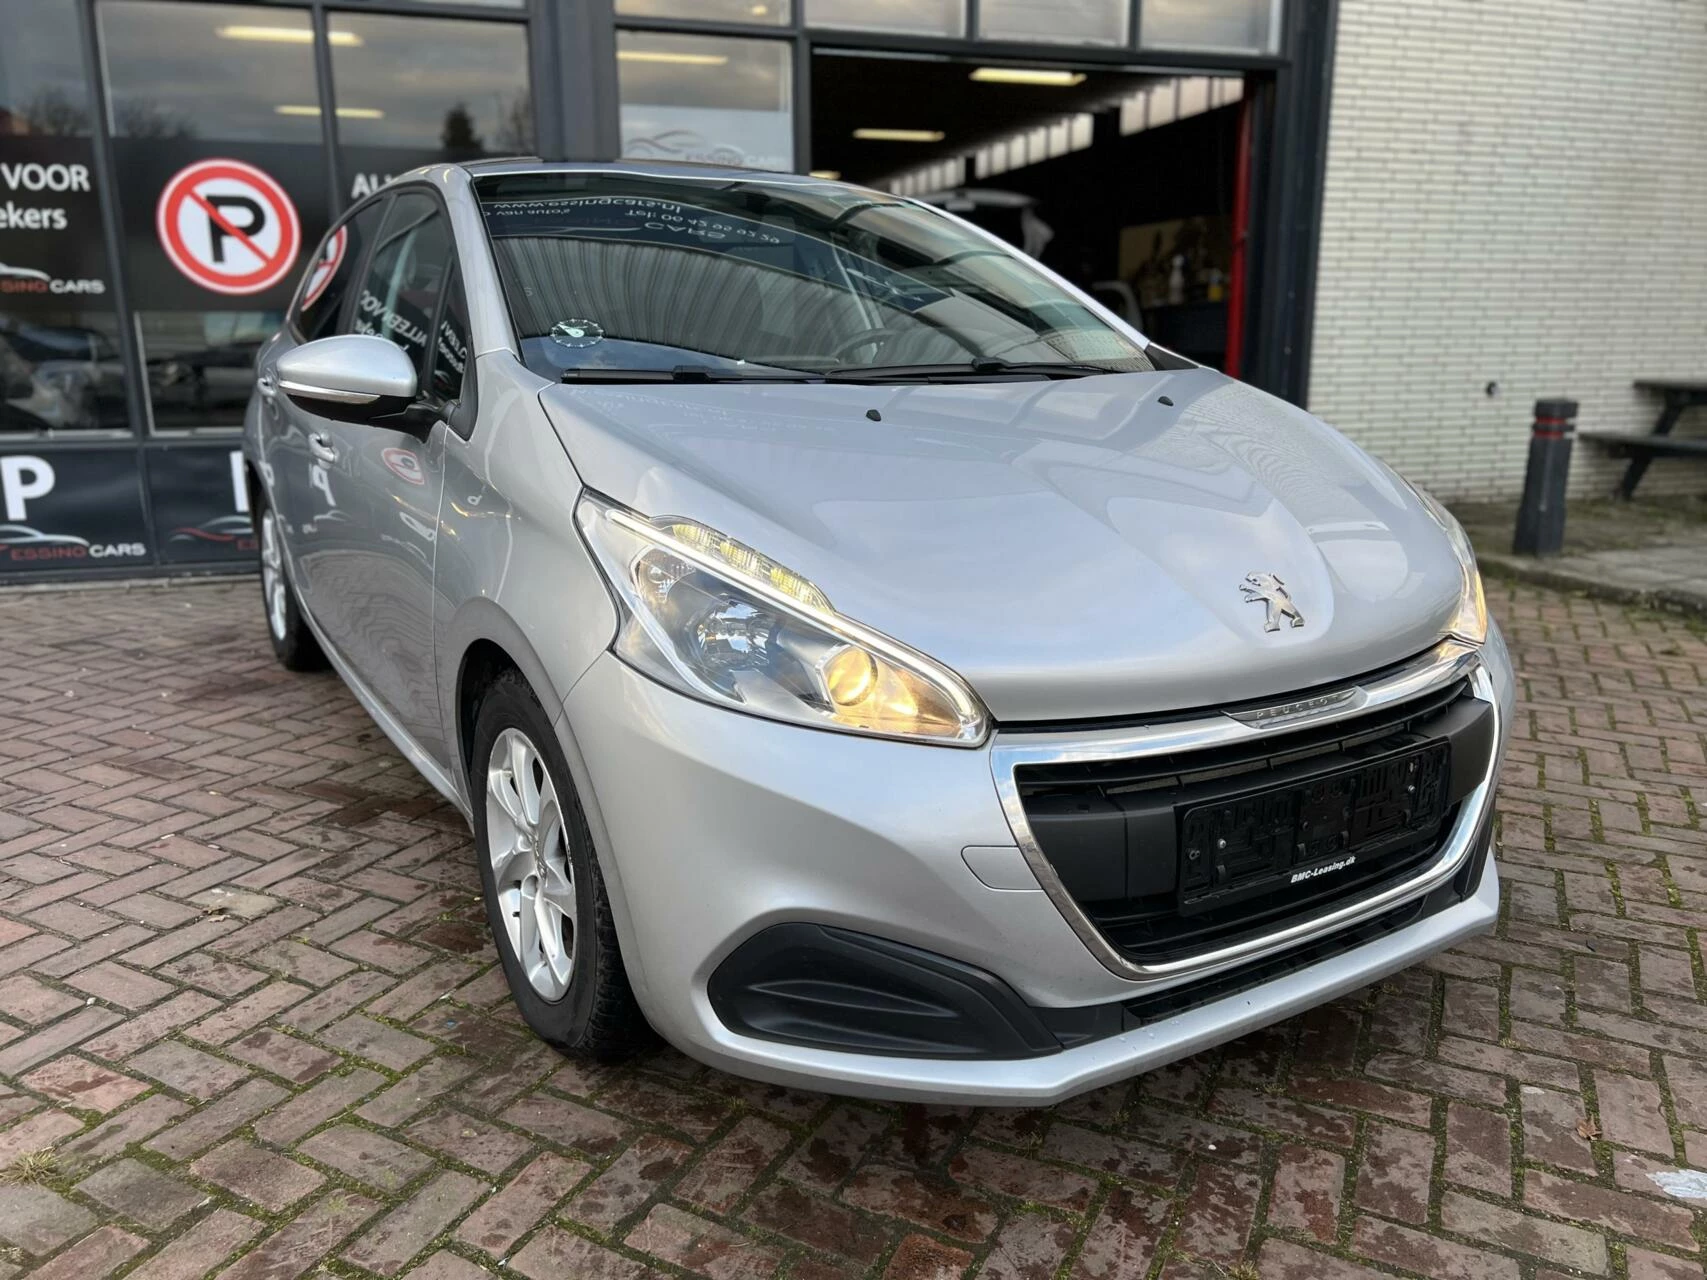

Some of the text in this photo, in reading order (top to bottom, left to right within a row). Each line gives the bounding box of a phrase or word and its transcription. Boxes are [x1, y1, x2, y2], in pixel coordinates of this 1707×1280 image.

[0, 163, 91, 191] VOOR
[206, 194, 265, 263] P
[50, 279, 106, 294] CARS
[0, 454, 56, 521] P
[88, 542, 147, 558] CARS
[1256, 694, 1338, 719] PEUGEOT
[1291, 856, 1357, 883] BMC-Leasing.dk
